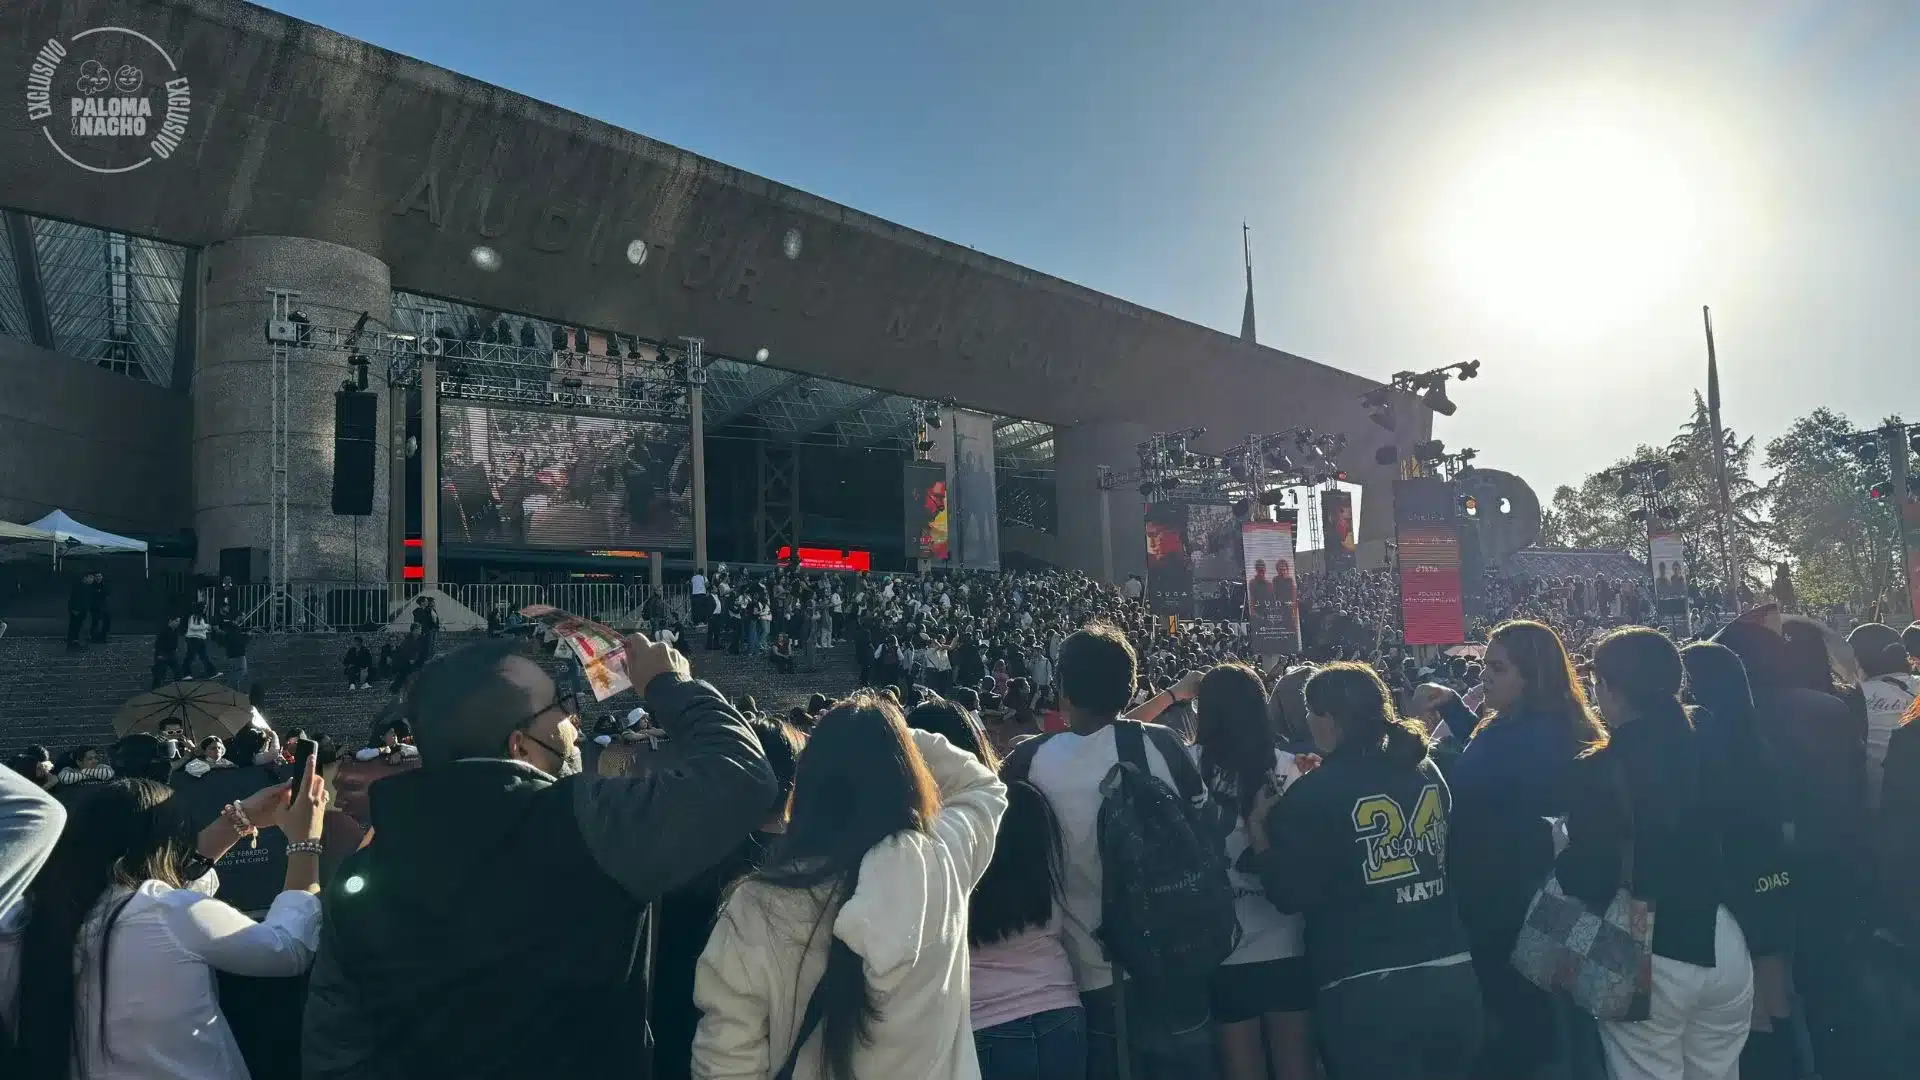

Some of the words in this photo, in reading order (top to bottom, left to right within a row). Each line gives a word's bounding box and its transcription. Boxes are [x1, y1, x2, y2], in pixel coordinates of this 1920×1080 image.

[392, 167, 832, 319] AUDITORO
[237, 848, 269, 857] FEBRERO
[1351, 784, 1444, 884] 24
[1396, 877, 1444, 904] NATU
